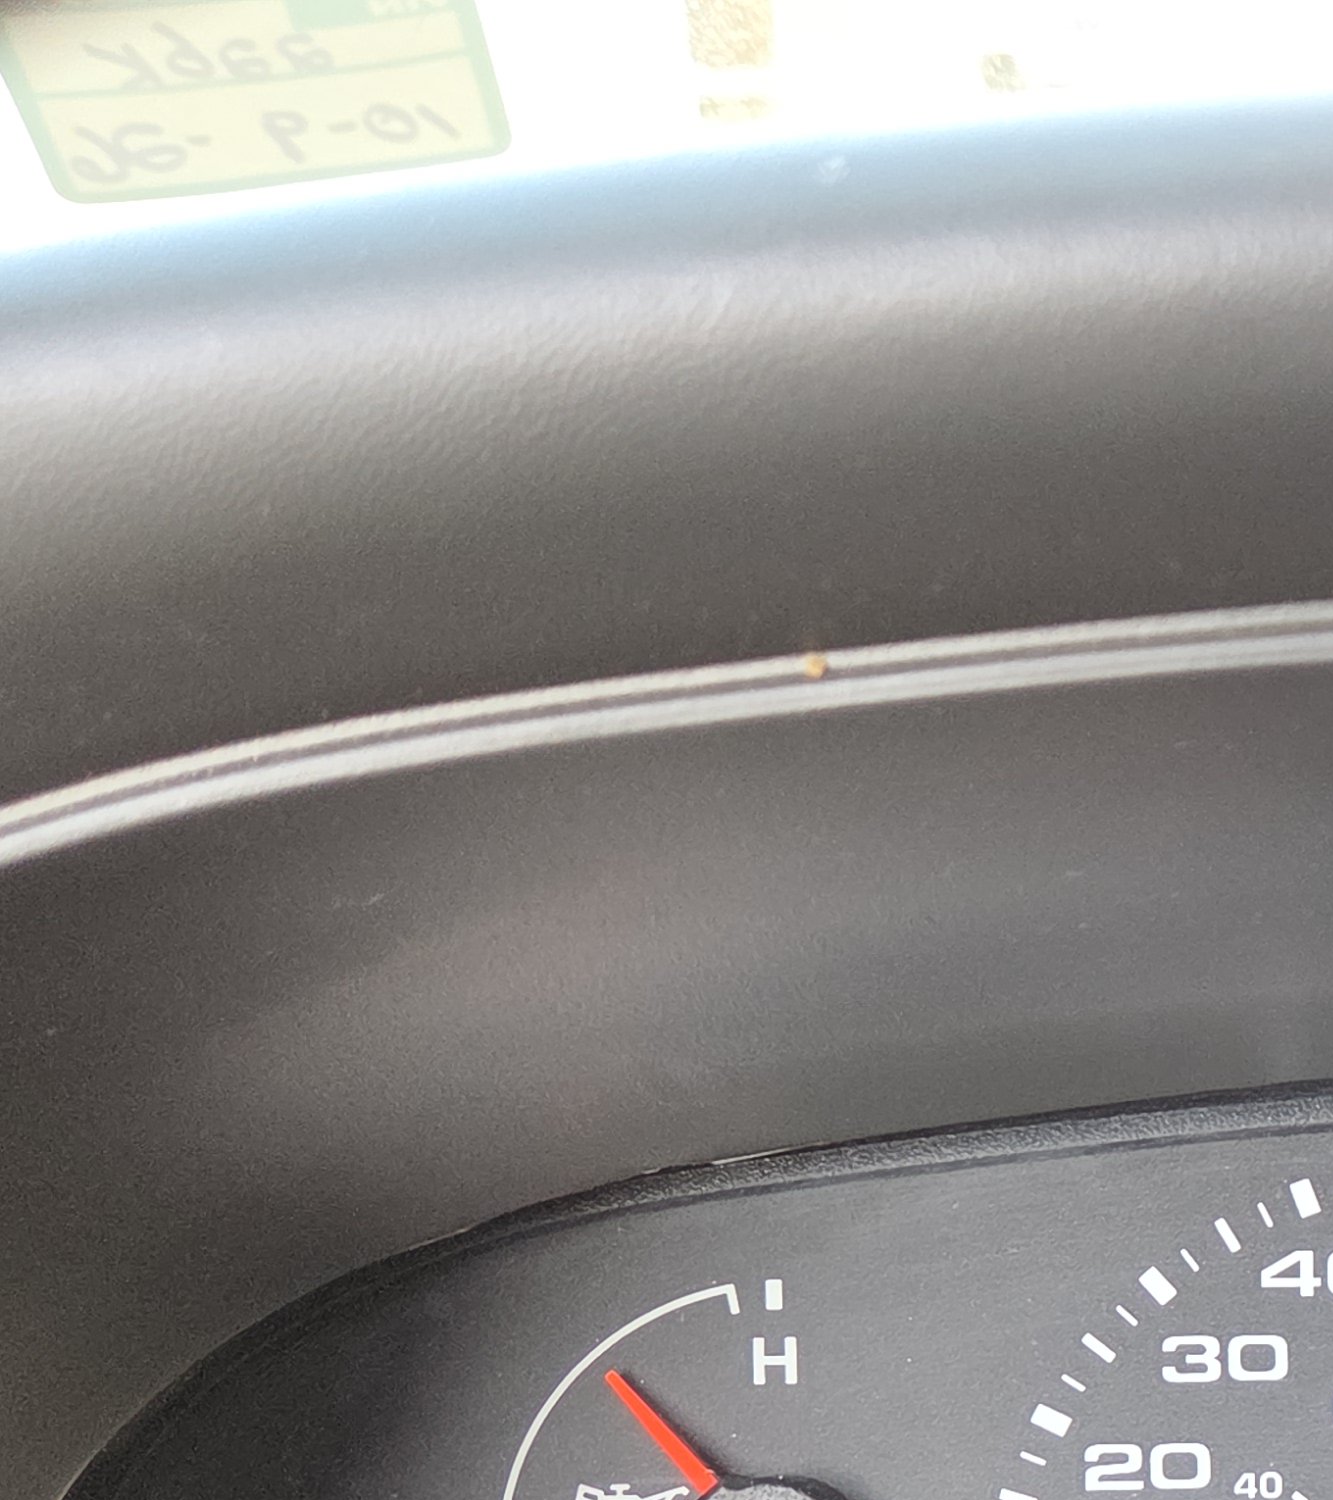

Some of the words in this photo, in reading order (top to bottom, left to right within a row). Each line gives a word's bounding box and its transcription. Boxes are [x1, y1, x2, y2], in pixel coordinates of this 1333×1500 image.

[753, 1337, 797, 1385] H
[1162, 1335, 1288, 1383] 30
[1084, 1443, 1211, 1491] 20
[1234, 1472, 1282, 1499] 40
